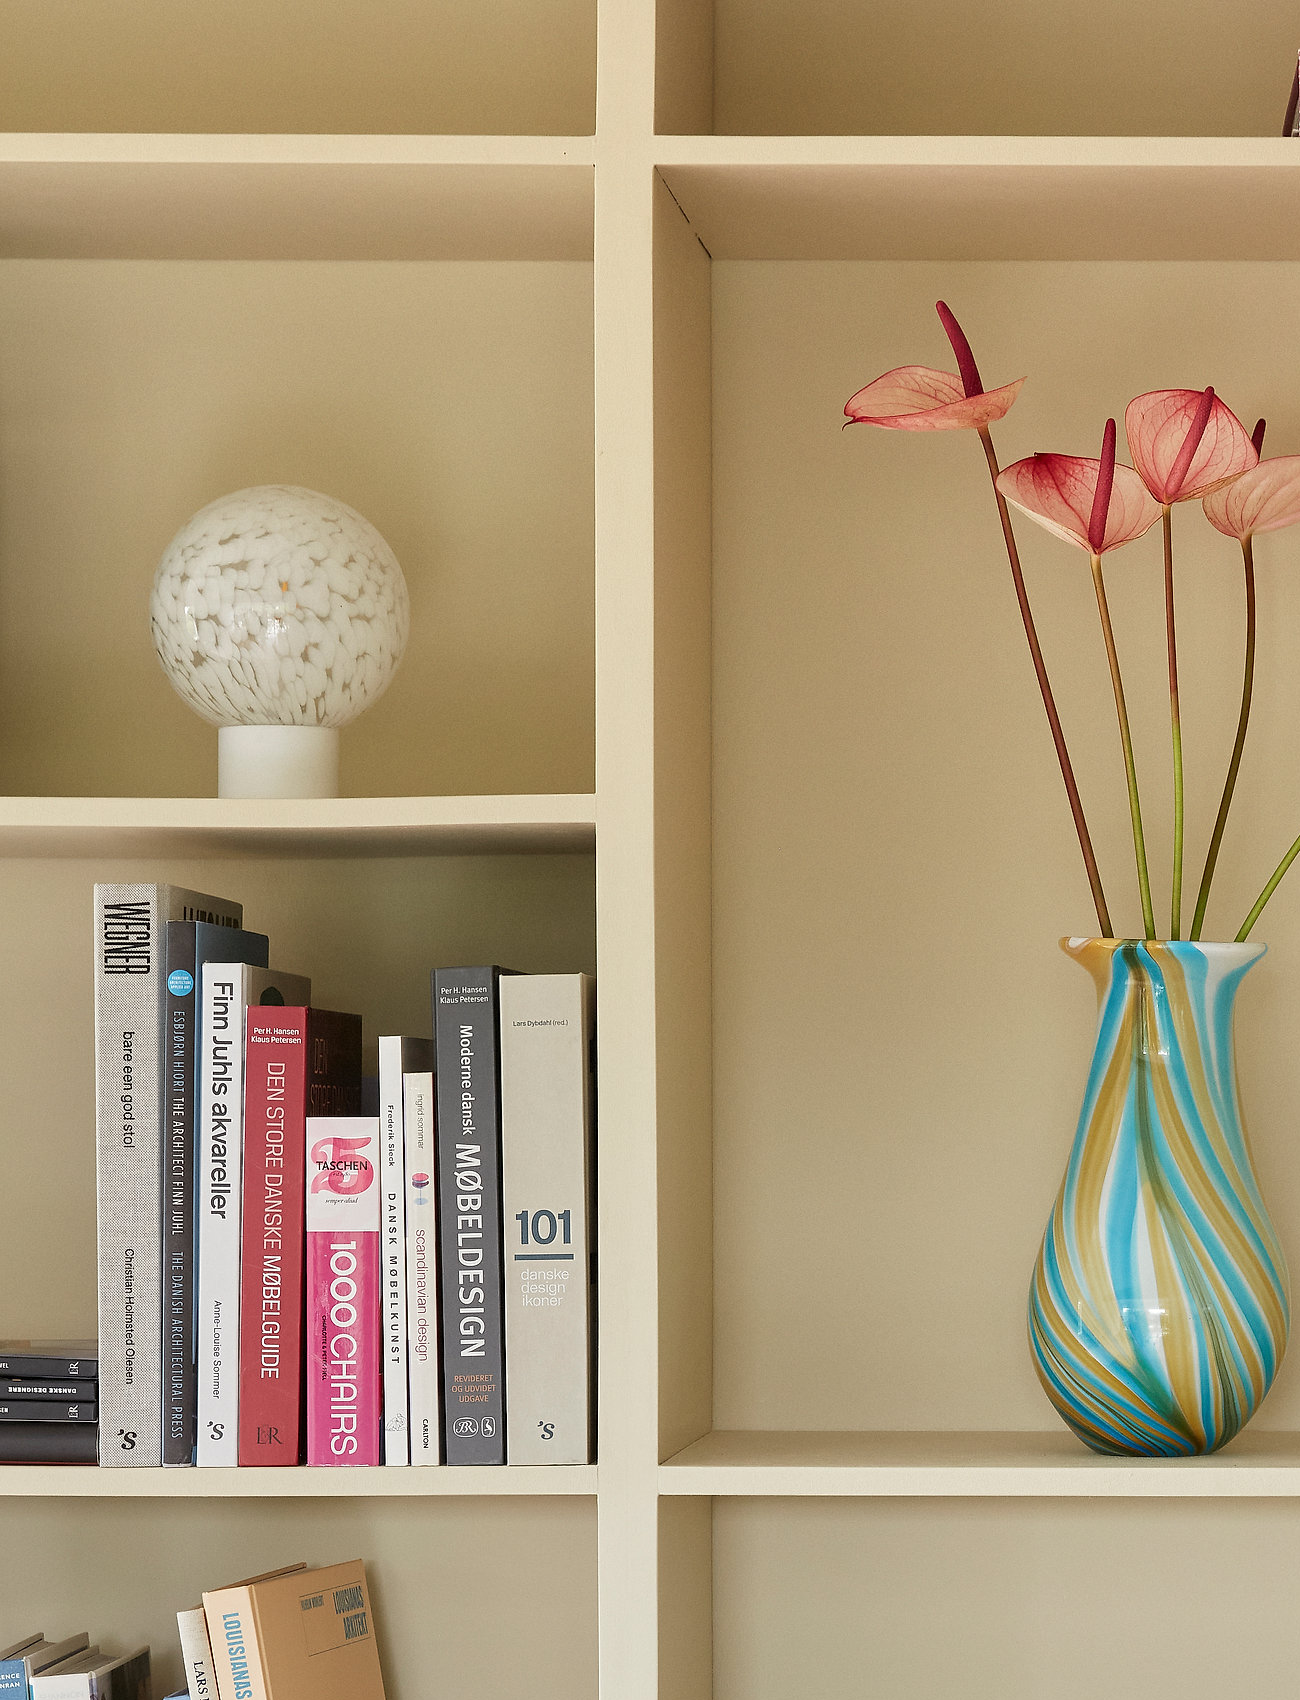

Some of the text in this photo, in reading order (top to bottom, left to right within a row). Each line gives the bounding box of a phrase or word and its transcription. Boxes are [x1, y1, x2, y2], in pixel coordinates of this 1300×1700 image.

[103, 902, 151, 975] WEGNER
[439, 995, 489, 1004] Klaus Petersen
[440, 986, 488, 995] Per H. Hansen
[171, 1011, 186, 1236] ESBJØRN HIORT THE ARCHITECT FINN JUHL
[210, 982, 234, 1220] Finn Juhls akvareller
[414, 1093, 425, 1116] ingrid
[387, 1104, 396, 1167] Frederik Sieck
[315, 1160, 368, 1171] TASCHEN
[454, 1025, 485, 1357] Moderne dansk MØBELDESIGN
[259, 1062, 286, 1379] DEN STORE DANSKE MØBELGUIDE
[515, 1209, 571, 1245] 101
[388, 1193, 400, 1364] DANSK MØBELKUNST
[414, 1229, 430, 1362] scandinavian design
[519, 1268, 570, 1281] danske
[521, 1281, 566, 1297] design
[123, 1248, 136, 1384] Christian Holmsted Olesen
[522, 1293, 563, 1307] ikoner
[212, 1300, 223, 1400] Anne-Louise Sommer
[330, 1242, 356, 1454] 1000 CHAIRS
[451, 1383, 497, 1393] OG UDVIDET
[454, 1374, 494, 1383] REVIDERET
[458, 1394, 489, 1403] UDGAVE
[193, 1661, 208, 1694] LARS
[221, 1612, 253, 1700] LOUISIANAS
